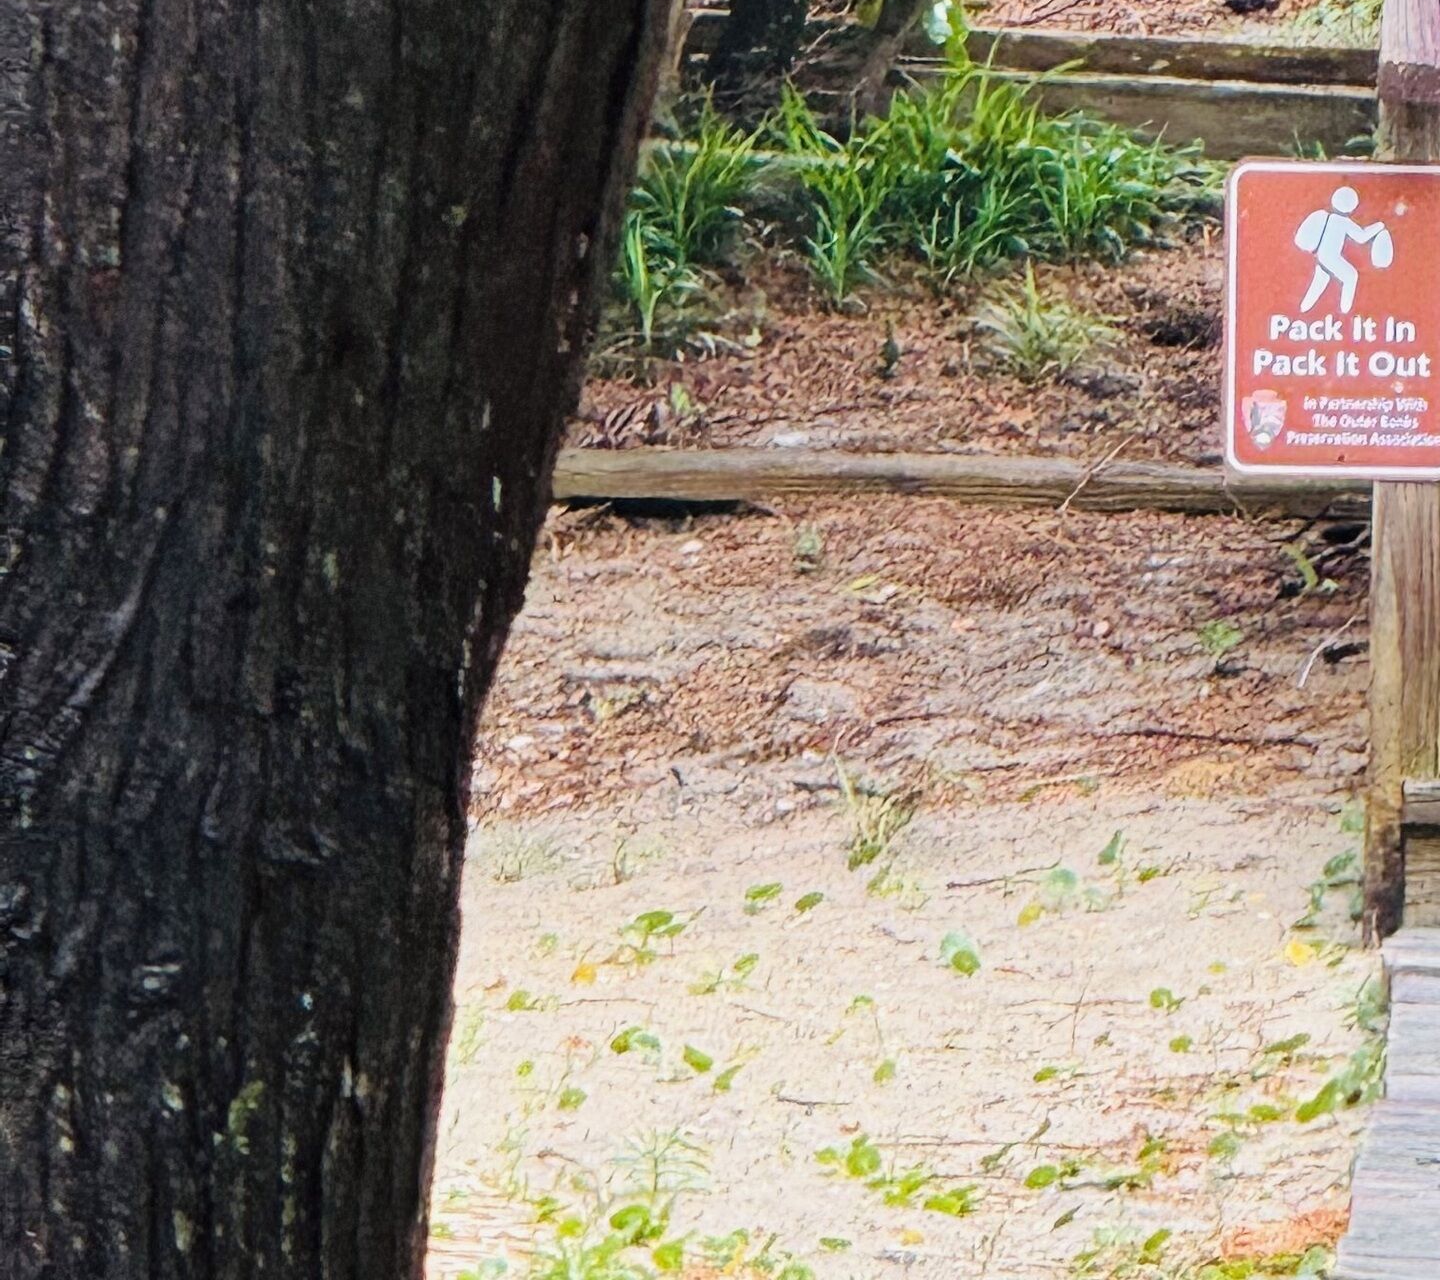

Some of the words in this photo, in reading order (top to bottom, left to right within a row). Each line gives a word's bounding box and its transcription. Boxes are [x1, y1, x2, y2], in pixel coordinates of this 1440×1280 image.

[1269, 313, 1343, 342] Pack
[1352, 315, 1377, 342] It
[1385, 316, 1416, 343] In
[1253, 348, 1326, 376] Pack
[1336, 351, 1360, 376] It
[1369, 352, 1431, 378] Out
[1312, 414, 1337, 427] The
